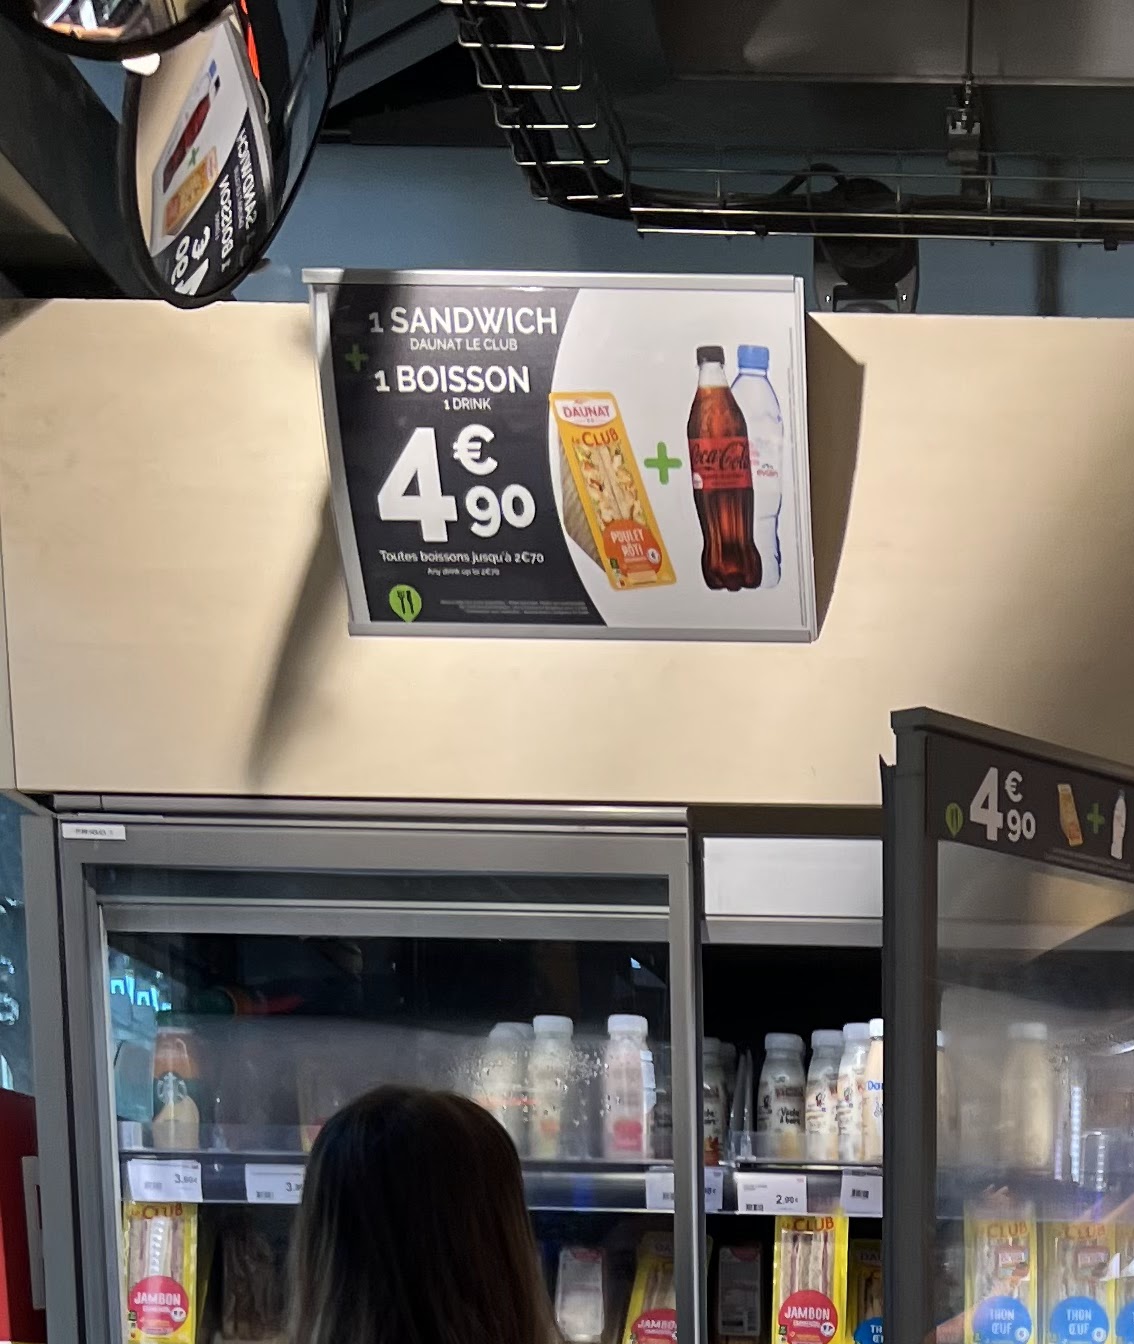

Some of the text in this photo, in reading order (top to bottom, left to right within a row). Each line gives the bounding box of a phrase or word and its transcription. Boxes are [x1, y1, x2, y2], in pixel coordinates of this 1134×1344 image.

[369, 306, 558, 335] 1 SANDWICH
[410, 338, 517, 351] DAUNAT LE CLUB
[374, 365, 530, 393] 1 BOISSON
[444, 397, 491, 411] 1 DRINK
[562, 405, 611, 419] DAUNAT
[581, 427, 619, 447] CLUB
[611, 529, 644, 544] POULET
[379, 550, 418, 562] Toutes
[420, 550, 470, 562] boissons
[471, 551, 512, 565] jusqu'à
[142, 1203, 183, 1219] CLUB
[793, 1216, 834, 1232] CLUB
[987, 1222, 1028, 1238] CLUB
[134, 1293, 181, 1305] JAMBON
[784, 1307, 830, 1321] JAMBON
[990, 1308, 1015, 1321] THON
[1066, 1309, 1092, 1321] THON
[637, 1319, 677, 1330] JAMBO
